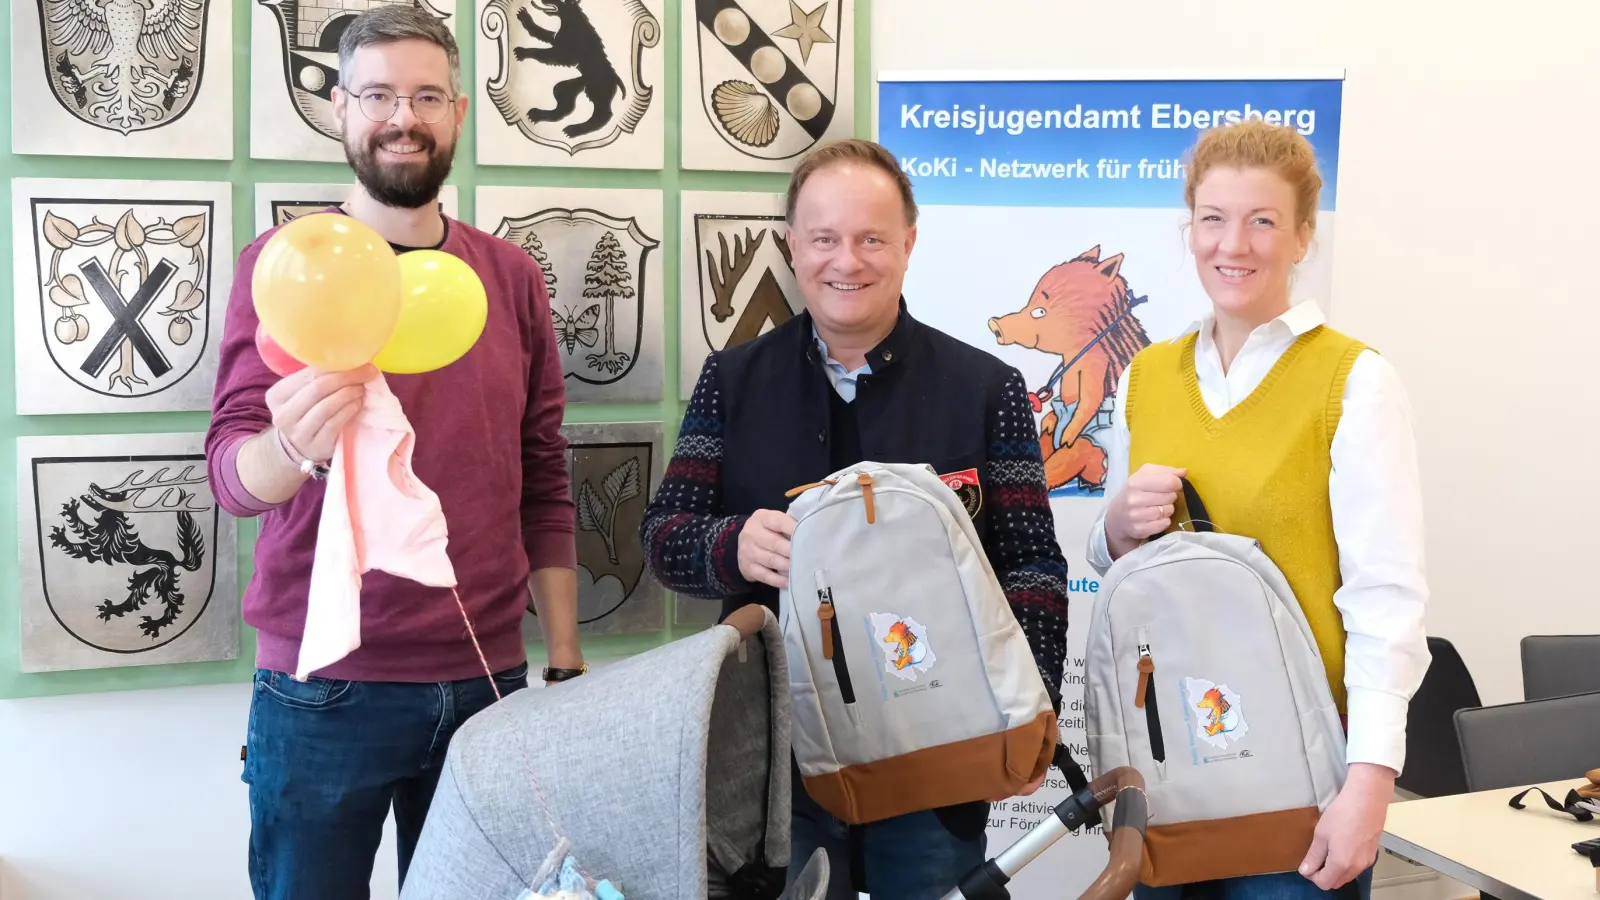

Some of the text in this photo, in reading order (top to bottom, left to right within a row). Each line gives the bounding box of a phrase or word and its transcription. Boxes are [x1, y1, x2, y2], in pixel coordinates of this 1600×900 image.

[900, 104, 1141, 135] Kreisjugendamt
[901, 157, 957, 178] KoKi
[980, 158, 1089, 179] Netzwerk
[1097, 158, 1131, 179] für
[1138, 158, 1186, 180] früh
[1069, 576, 1100, 593] ute
[1058, 716, 1085, 729] zeiti
[1012, 801, 1055, 815] aktivie
